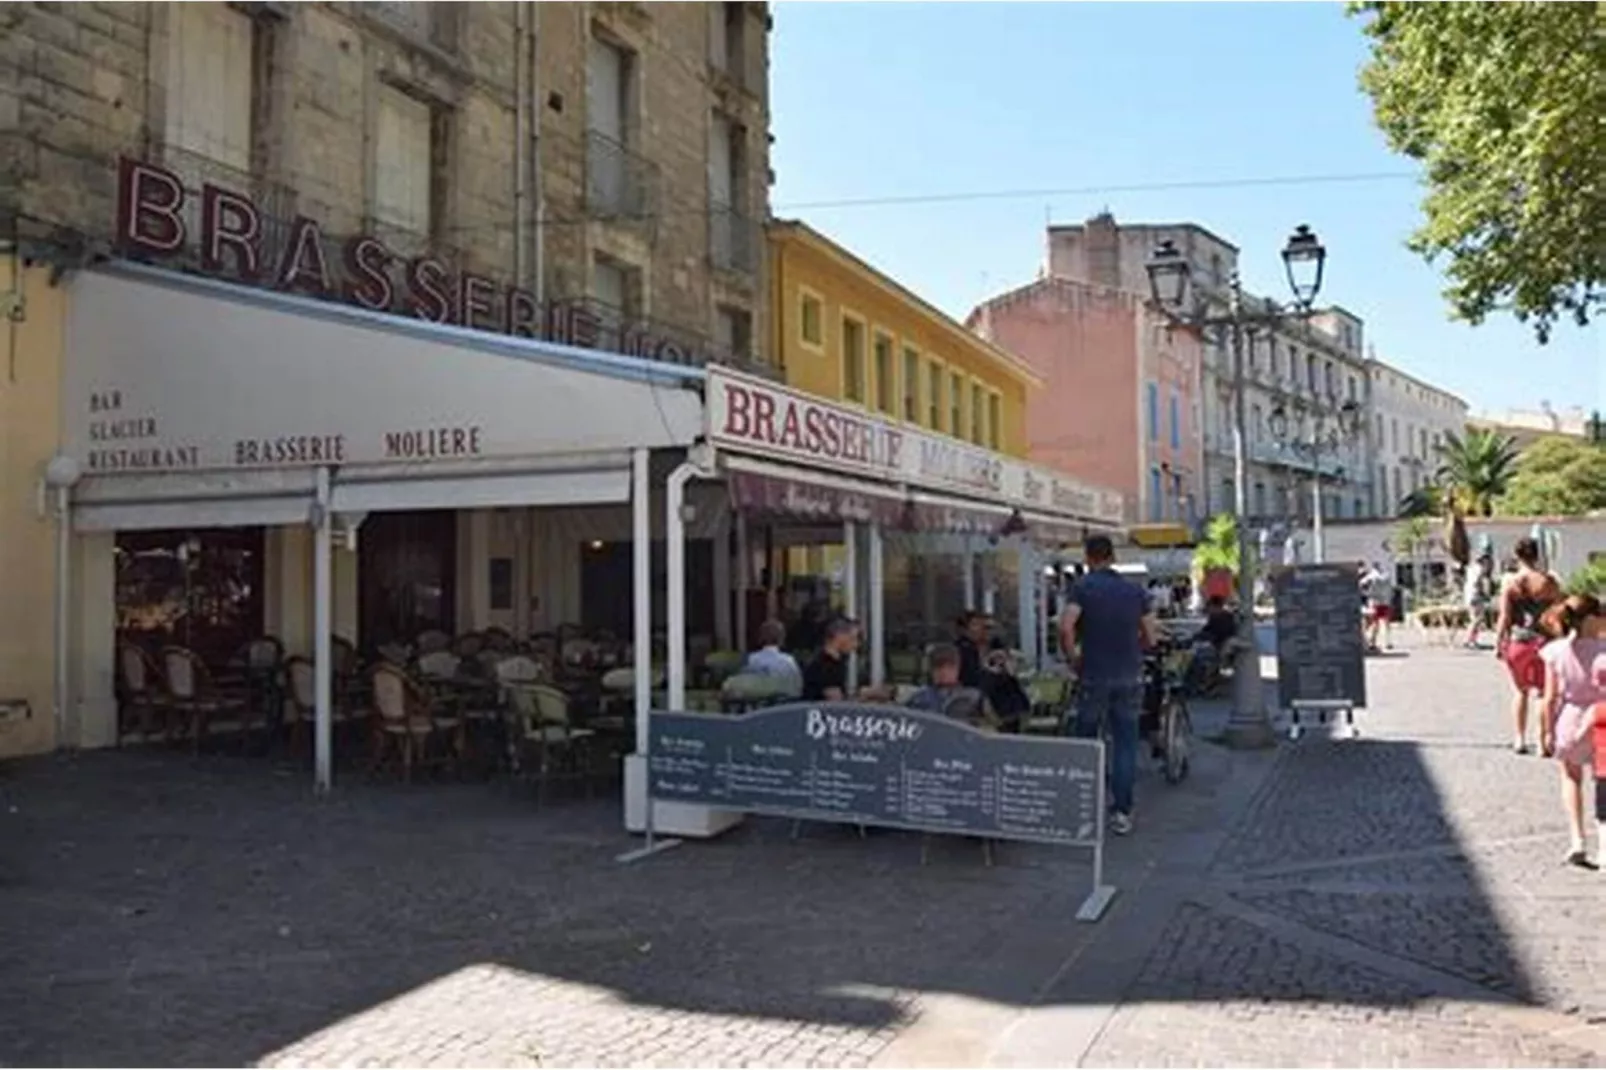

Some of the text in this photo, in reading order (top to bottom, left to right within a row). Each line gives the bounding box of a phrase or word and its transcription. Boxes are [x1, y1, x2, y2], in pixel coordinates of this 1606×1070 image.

[114, 154, 602, 347] BRASSERIE
[88, 446, 200, 471] RESTAURANT
[235, 434, 345, 464] BRASSERIE
[724, 384, 904, 468] BRASSERIE
[805, 708, 925, 741] Brasserie
